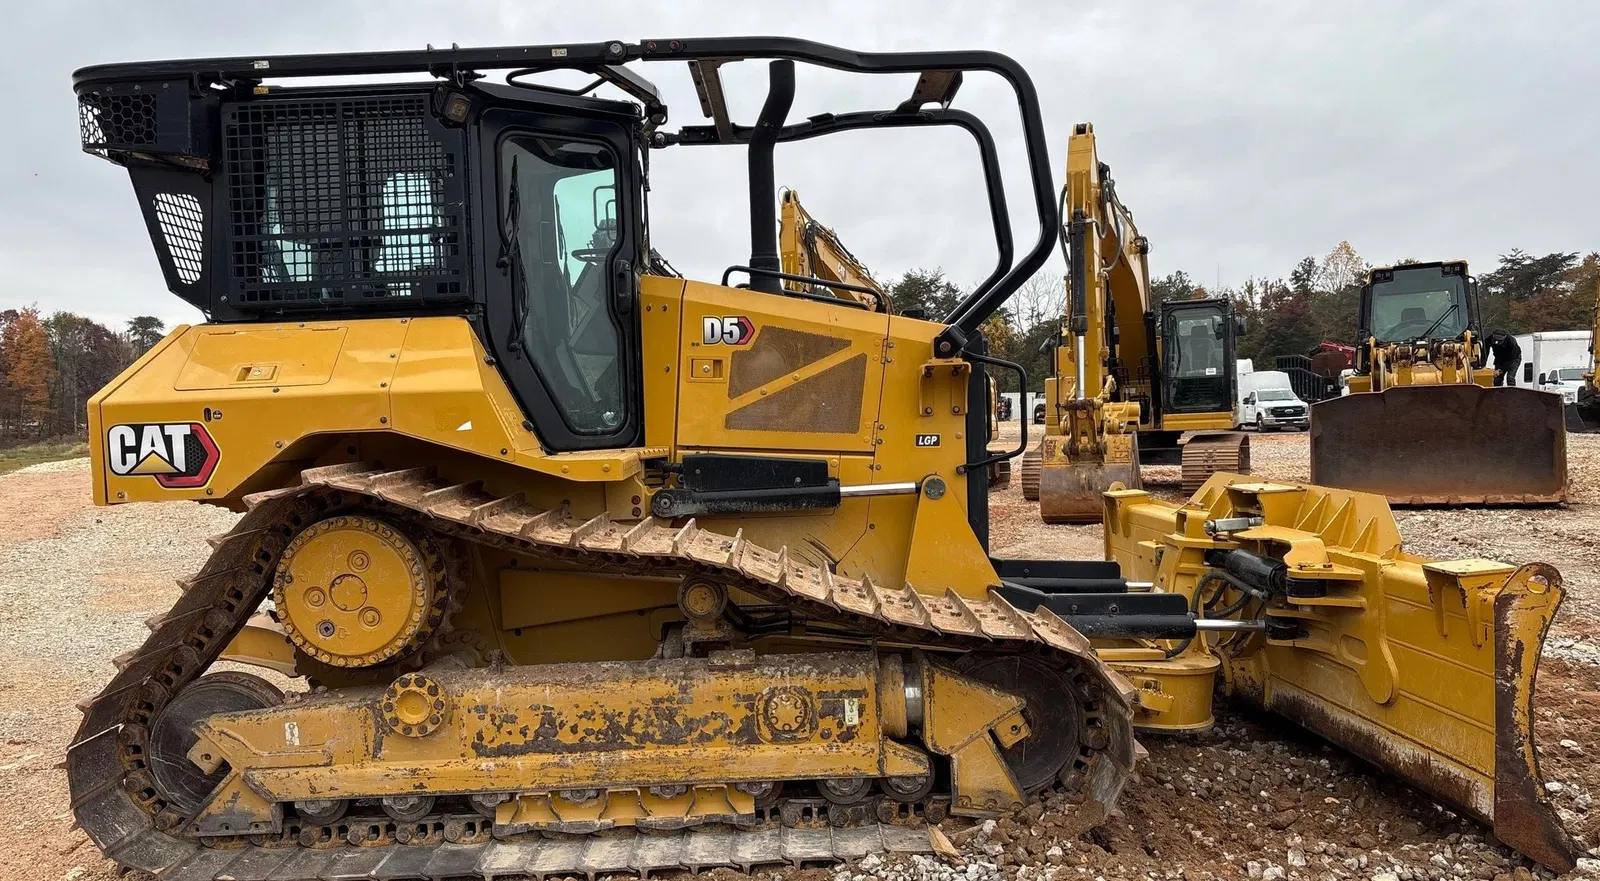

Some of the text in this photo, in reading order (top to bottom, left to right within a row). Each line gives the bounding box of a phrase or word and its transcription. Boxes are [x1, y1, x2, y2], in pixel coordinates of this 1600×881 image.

[703, 317, 740, 344] D5
[108, 424, 191, 475] CAT
[918, 435, 938, 446] LGP
